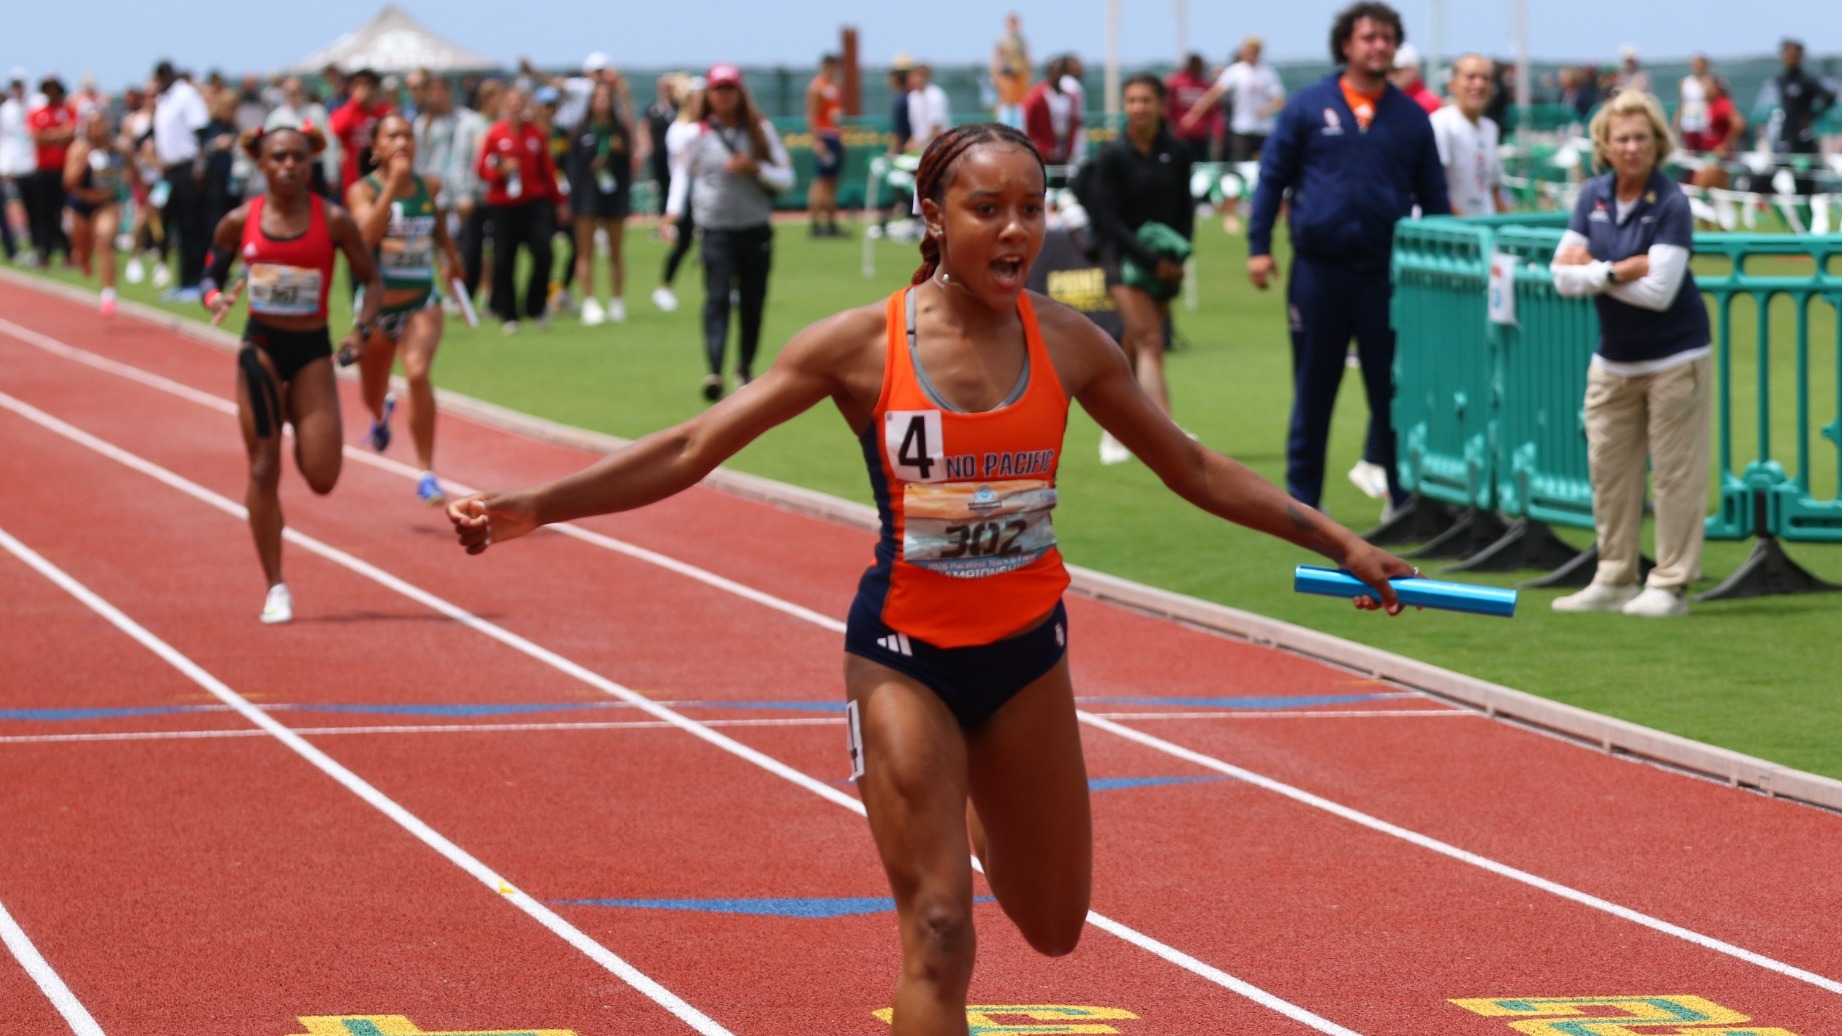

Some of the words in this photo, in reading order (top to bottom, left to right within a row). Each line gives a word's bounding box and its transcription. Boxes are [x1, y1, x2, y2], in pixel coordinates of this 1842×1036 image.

[898, 415, 934, 479] 4
[984, 450, 1054, 477] PACIFIC
[940, 519, 1027, 558] 302
